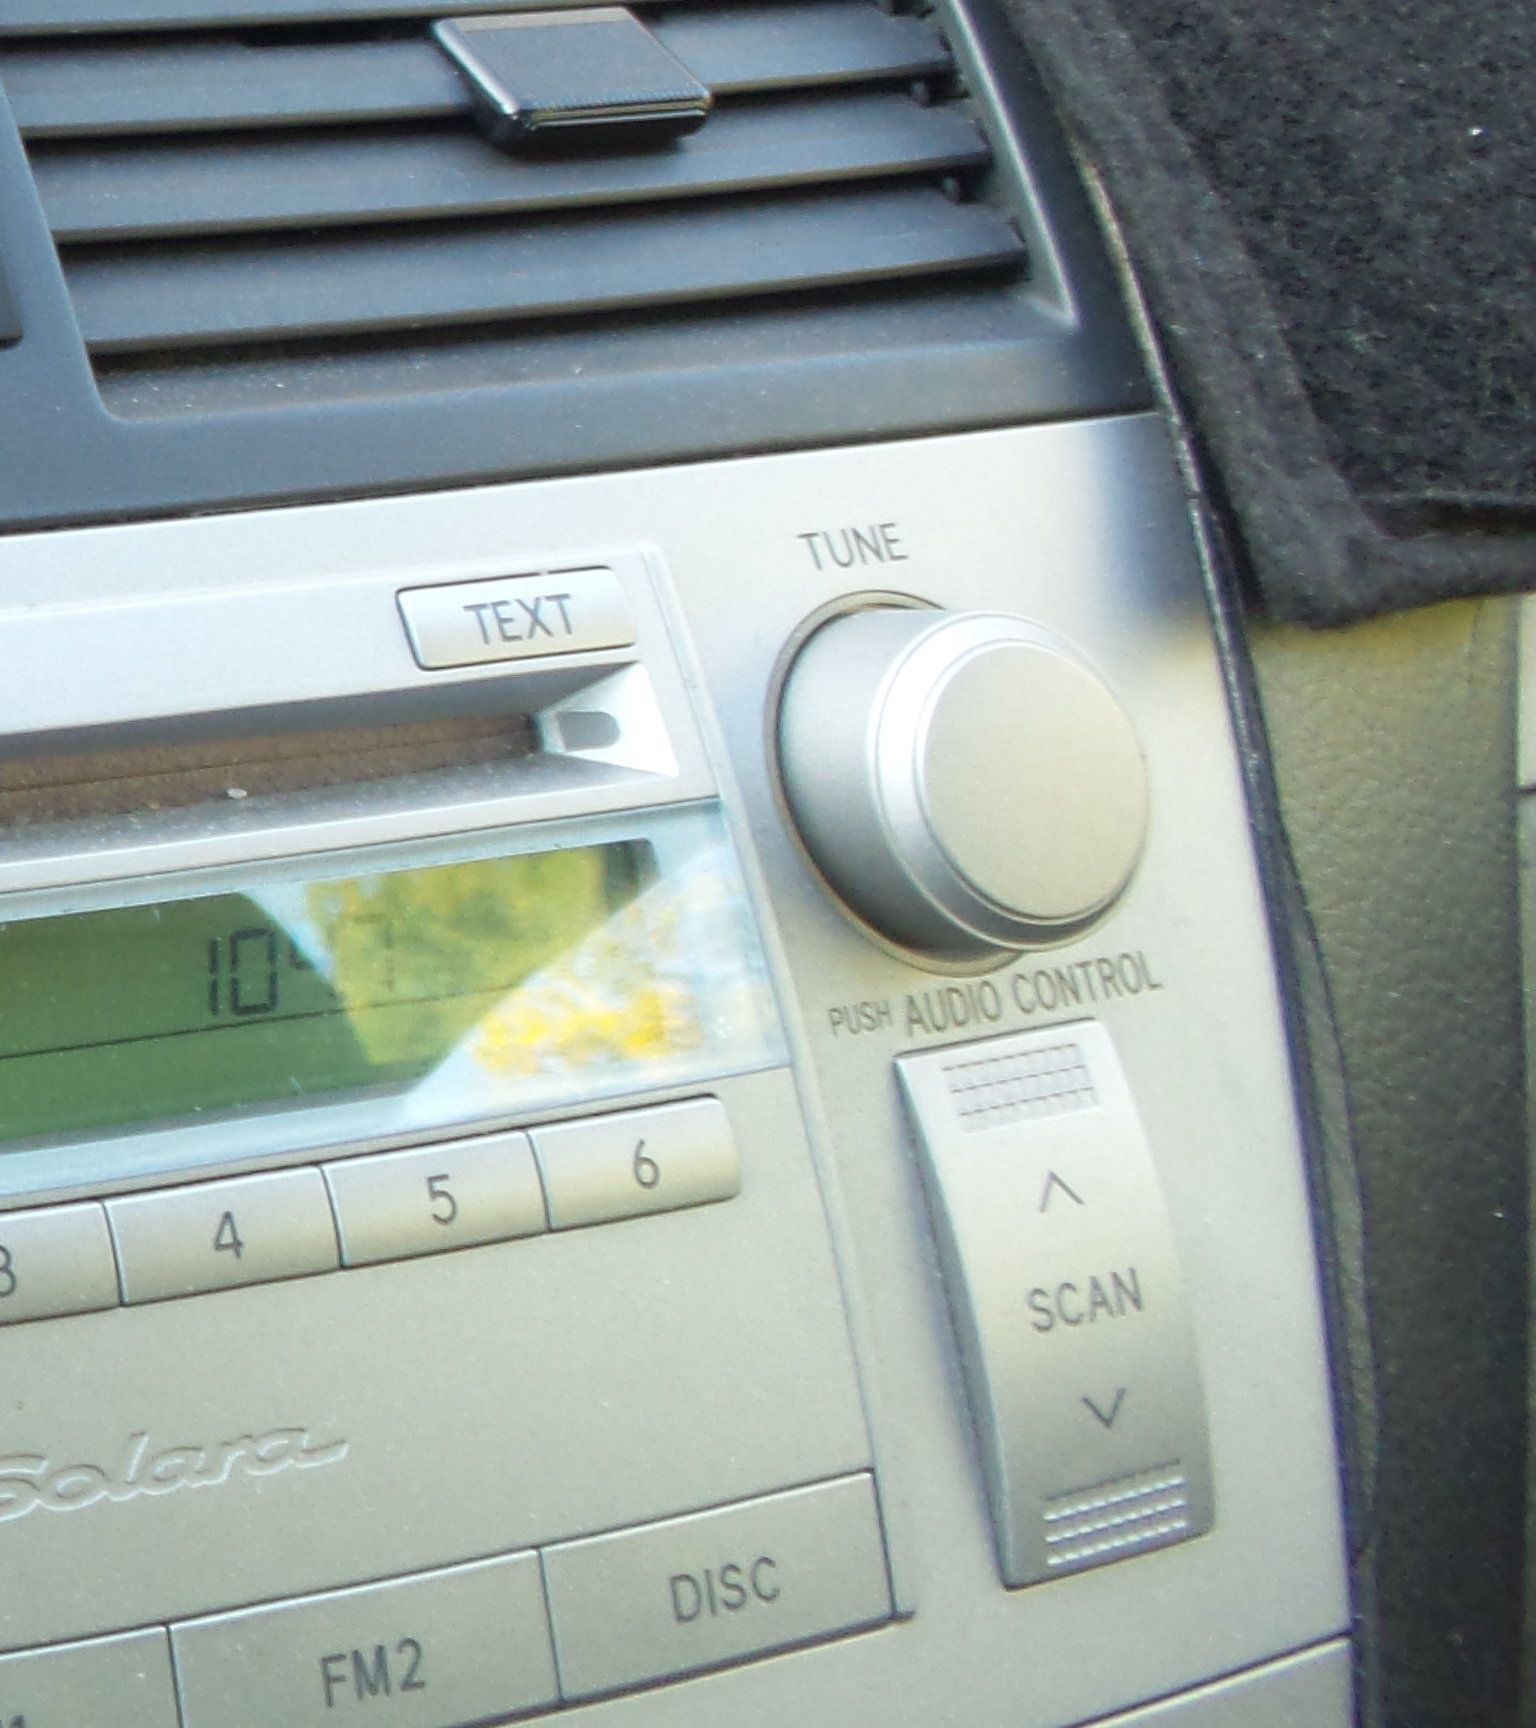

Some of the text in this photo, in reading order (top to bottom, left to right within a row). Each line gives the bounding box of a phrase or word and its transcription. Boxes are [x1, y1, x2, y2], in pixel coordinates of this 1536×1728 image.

[796, 521, 909, 572] TUNE
[462, 592, 579, 647] TEXT
[828, 950, 1165, 1039] PUSH AUDIO CONTROL
[632, 1138, 662, 1191] 6
[425, 1174, 460, 1227] 5
[212, 1209, 246, 1260] 4
[1027, 1266, 1146, 1334] SCAN
[670, 1555, 783, 1627] DISC
[318, 1636, 428, 1710] FM2
